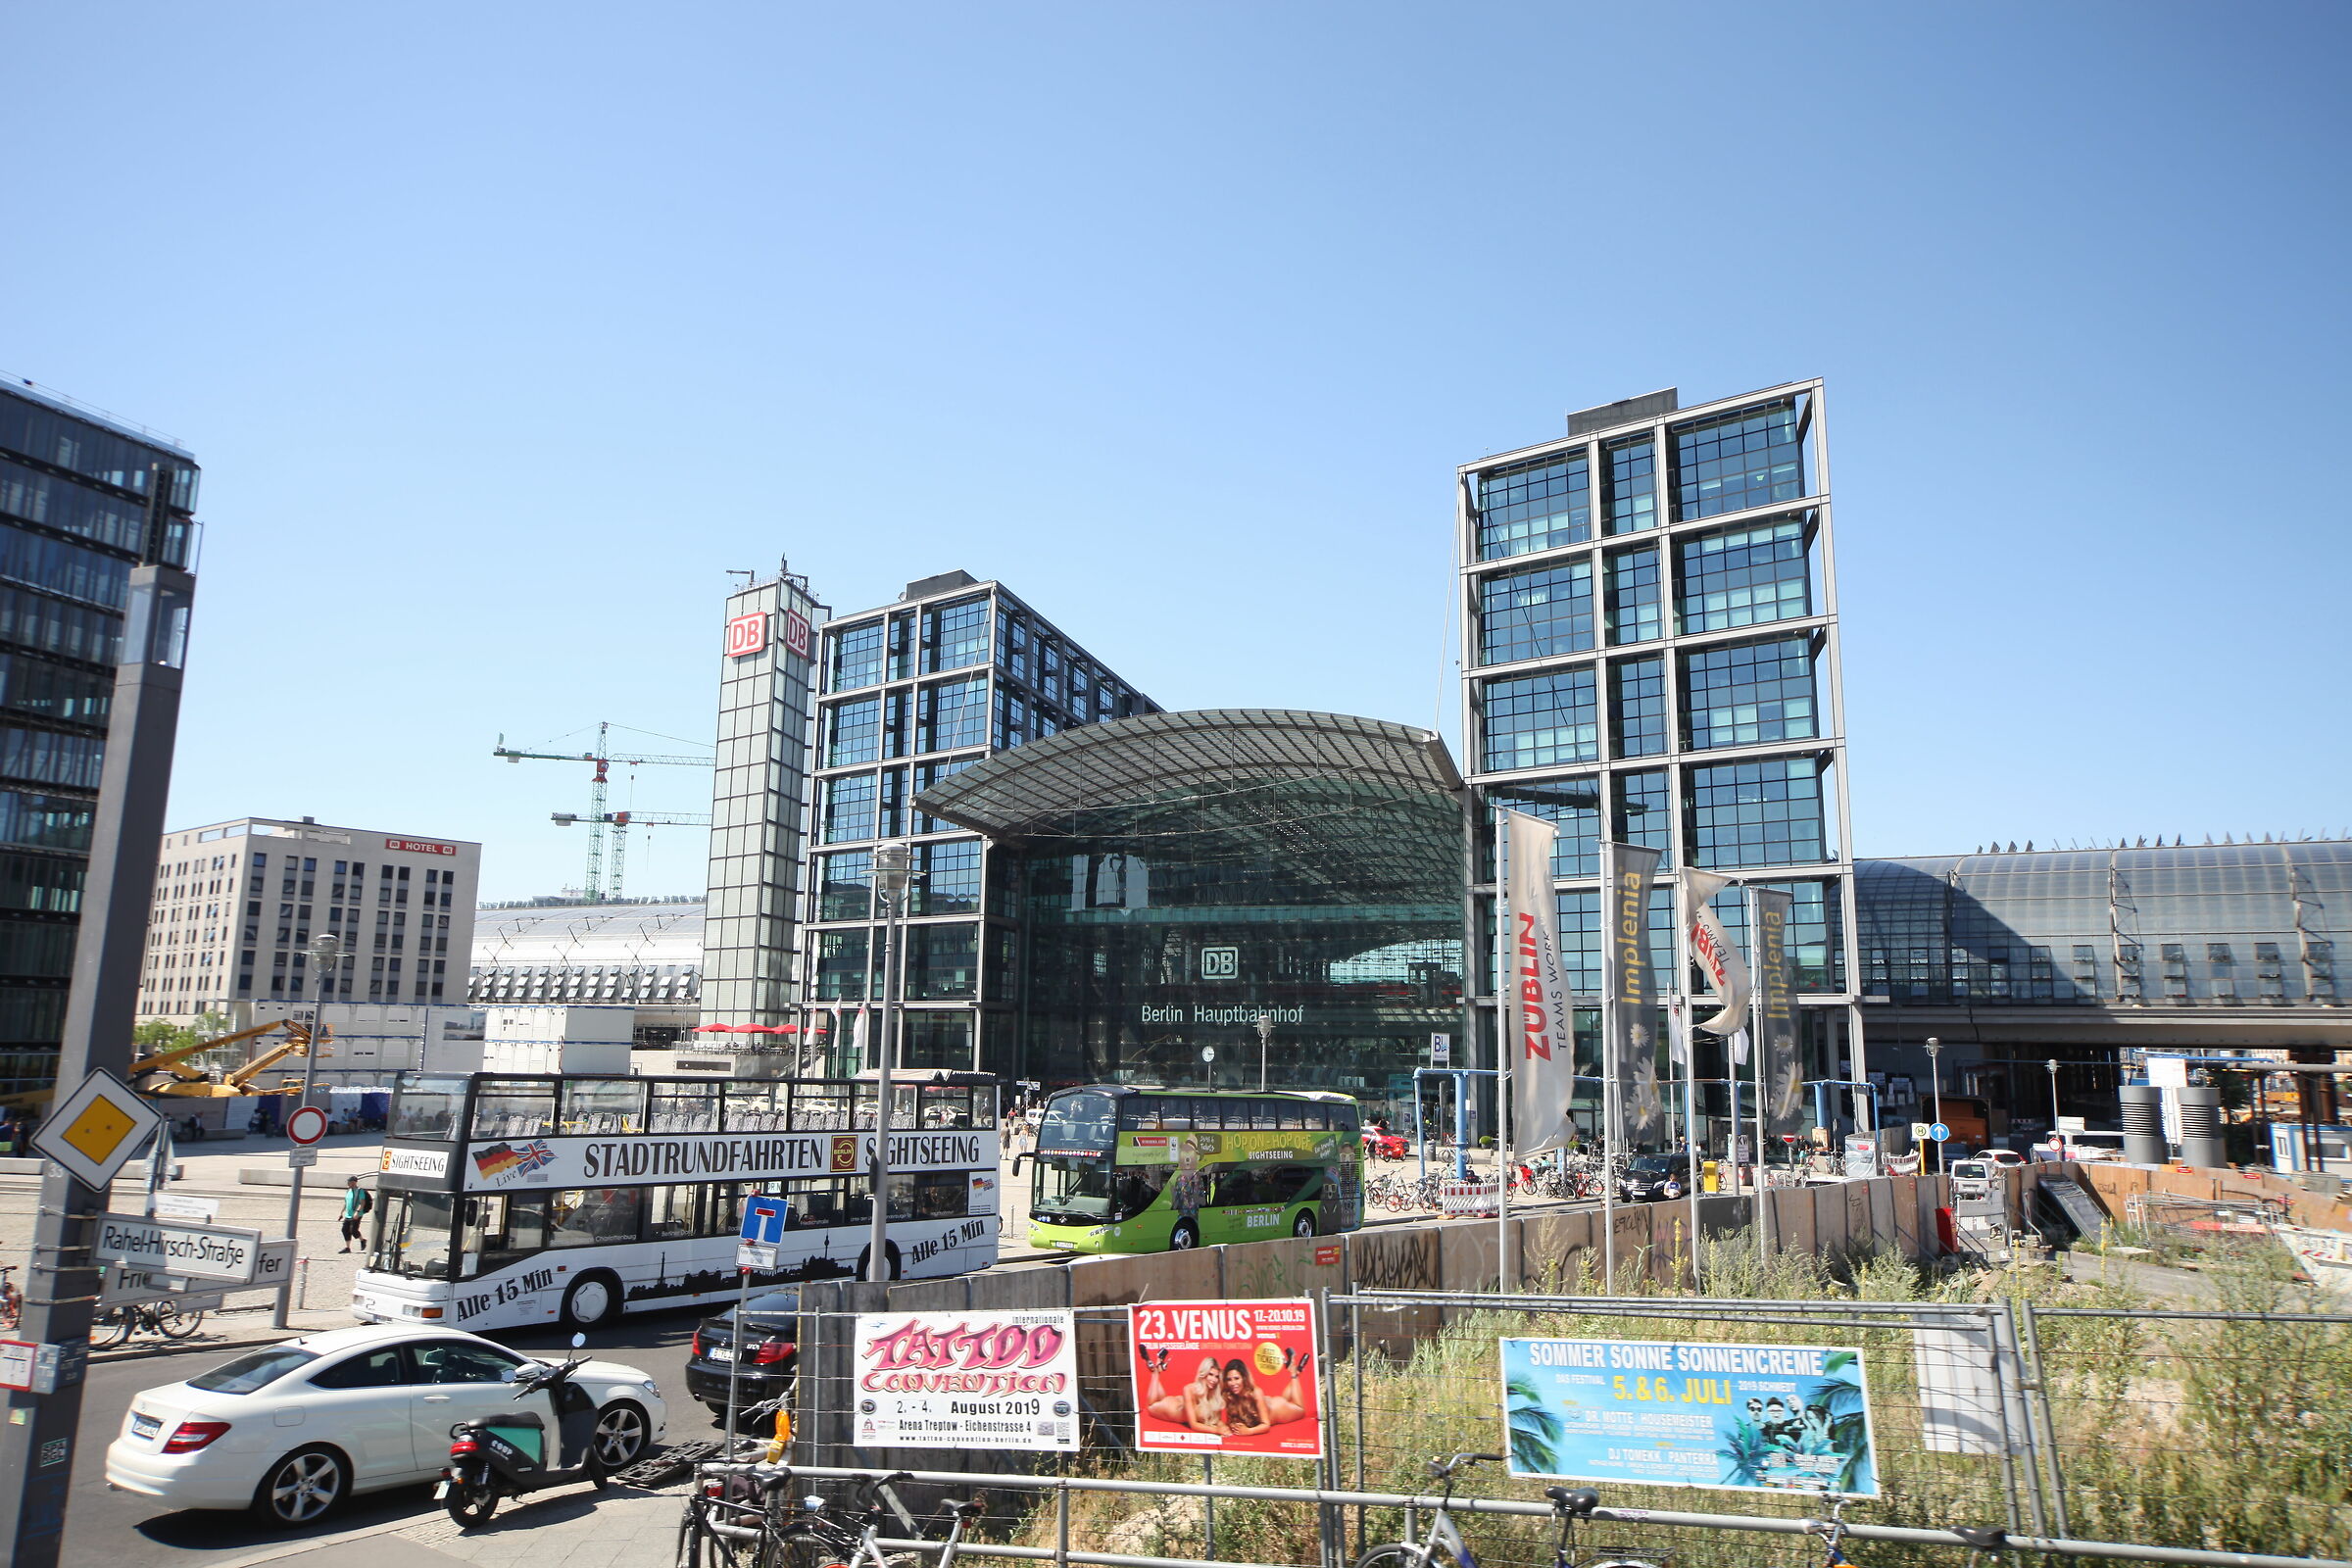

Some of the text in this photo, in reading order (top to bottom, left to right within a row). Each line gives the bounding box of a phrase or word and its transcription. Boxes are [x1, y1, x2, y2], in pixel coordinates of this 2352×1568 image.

[732, 619, 760, 651] DB
[788, 615, 807, 651] DB
[405, 842, 438, 853] HOTEL
[1617, 871, 1646, 1005] Implenia
[1204, 951, 1235, 976] DB
[1761, 911, 1789, 1019] Implenia
[1519, 912, 1552, 1062] ZÜBLIN
[1543, 930, 1568, 1051] TEAMS WORK
[1142, 1004, 1304, 1026] Berlin Hauptbahnhof
[1226, 1133, 1248, 1151] HOP
[1250, 1134, 1265, 1151] ON
[1272, 1133, 1293, 1149] HOP
[1294, 1135, 1312, 1151] OFF
[1248, 1151, 1294, 1160] SIGHTSEEING
[391, 1154, 445, 1172] SIGHTSEEING
[583, 1139, 824, 1179] STADTRUNDFAHRTEN
[865, 1136, 980, 1166] SGHTSEEING
[496, 1169, 517, 1188] Live
[1247, 1214, 1280, 1228] BERLIN
[103, 1226, 245, 1269] Rahel-Hirsch-Straße
[911, 1219, 985, 1265] Alle 15 Min
[457, 1294, 491, 1323] Alle
[494, 1278, 518, 1305] 15
[522, 1267, 555, 1295] Min
[1011, 1315, 1064, 1324] internationale
[861, 1317, 1066, 1371] TATTOO
[1529, 1343, 1825, 1376] SOMMER SONNE SONNENCREME
[860, 1371, 1068, 1398] CONVENTION
[1571, 1374, 1606, 1386] FESTIVAL
[1612, 1375, 1634, 1401] 5.
[1636, 1376, 1653, 1401] &
[1654, 1377, 1676, 1402] 6.
[1681, 1378, 1733, 1404] JULI
[897, 1400, 907, 1414] 2.
[921, 1400, 932, 1413] 4.
[951, 1400, 1002, 1415] August
[1005, 1398, 1041, 1415] 2019
[1602, 1410, 1635, 1424] MOTTE
[899, 1420, 923, 1431] Arena
[924, 1420, 957, 1432] Treptow
[965, 1420, 1024, 1432] Eichenstrasse
[1026, 1421, 1031, 1431] 4
[1607, 1447, 1621, 1460] DJ
